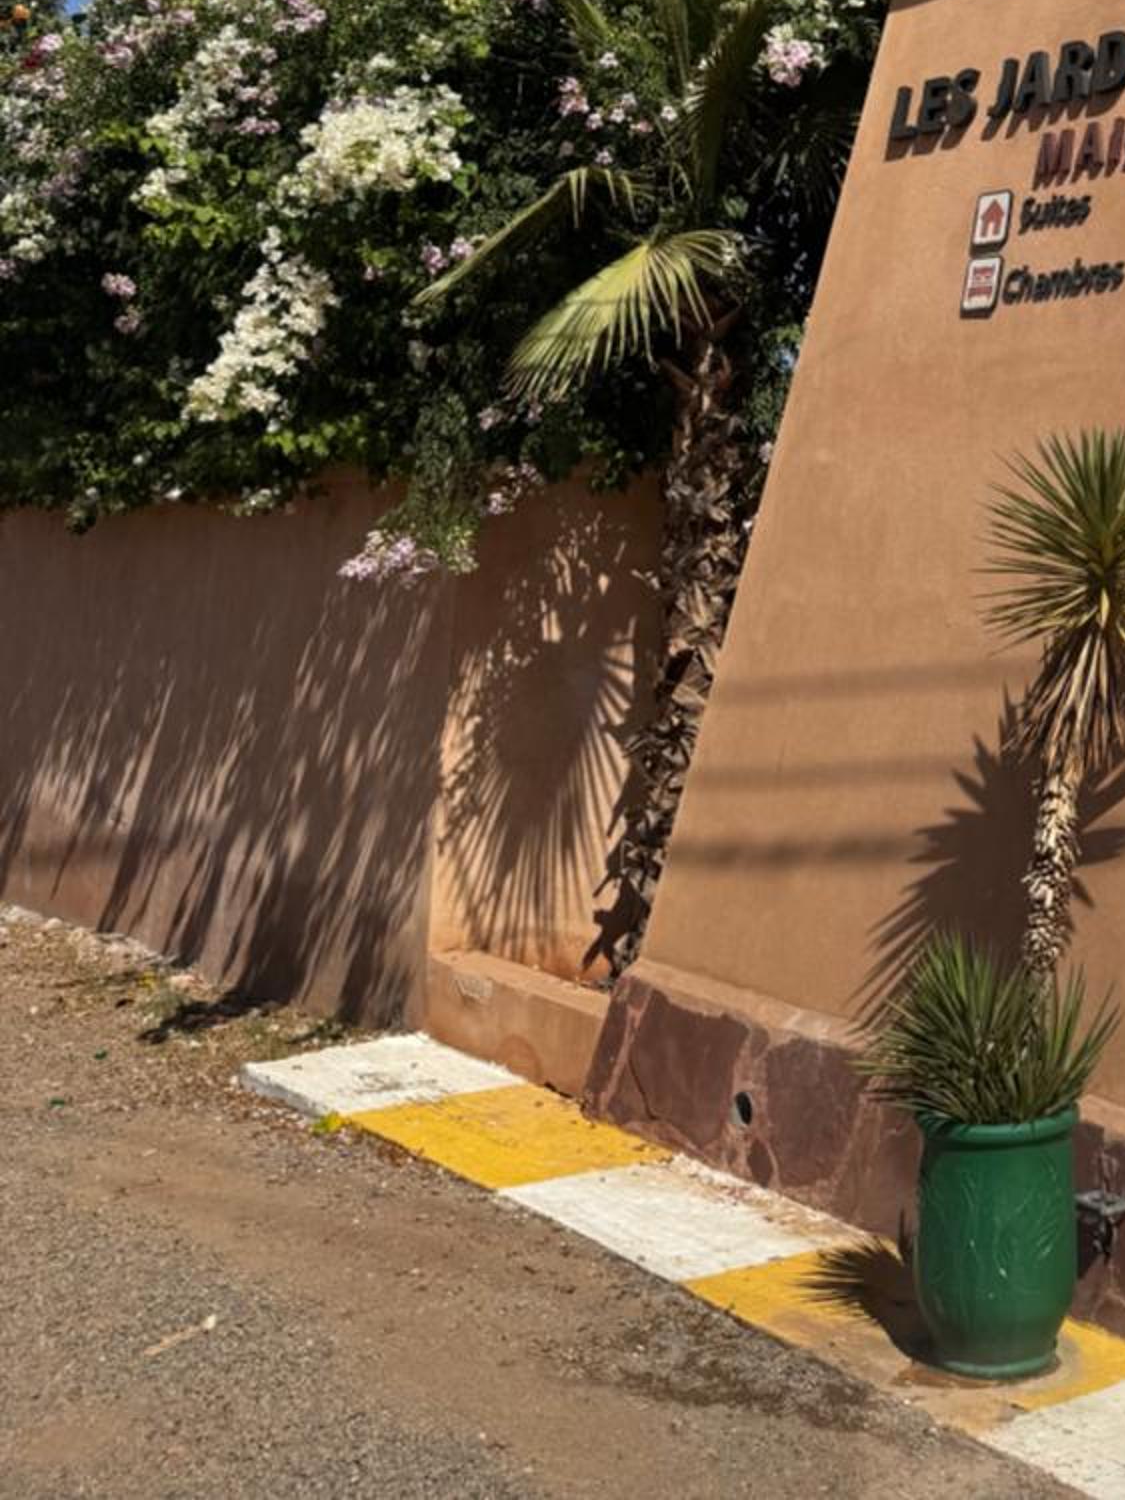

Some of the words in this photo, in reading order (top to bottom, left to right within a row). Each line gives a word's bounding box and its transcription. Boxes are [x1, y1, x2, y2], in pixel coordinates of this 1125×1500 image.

[888, 69, 980, 142] LES
[1020, 196, 1091, 234] Suites
[1003, 258, 1125, 304] Chambres
